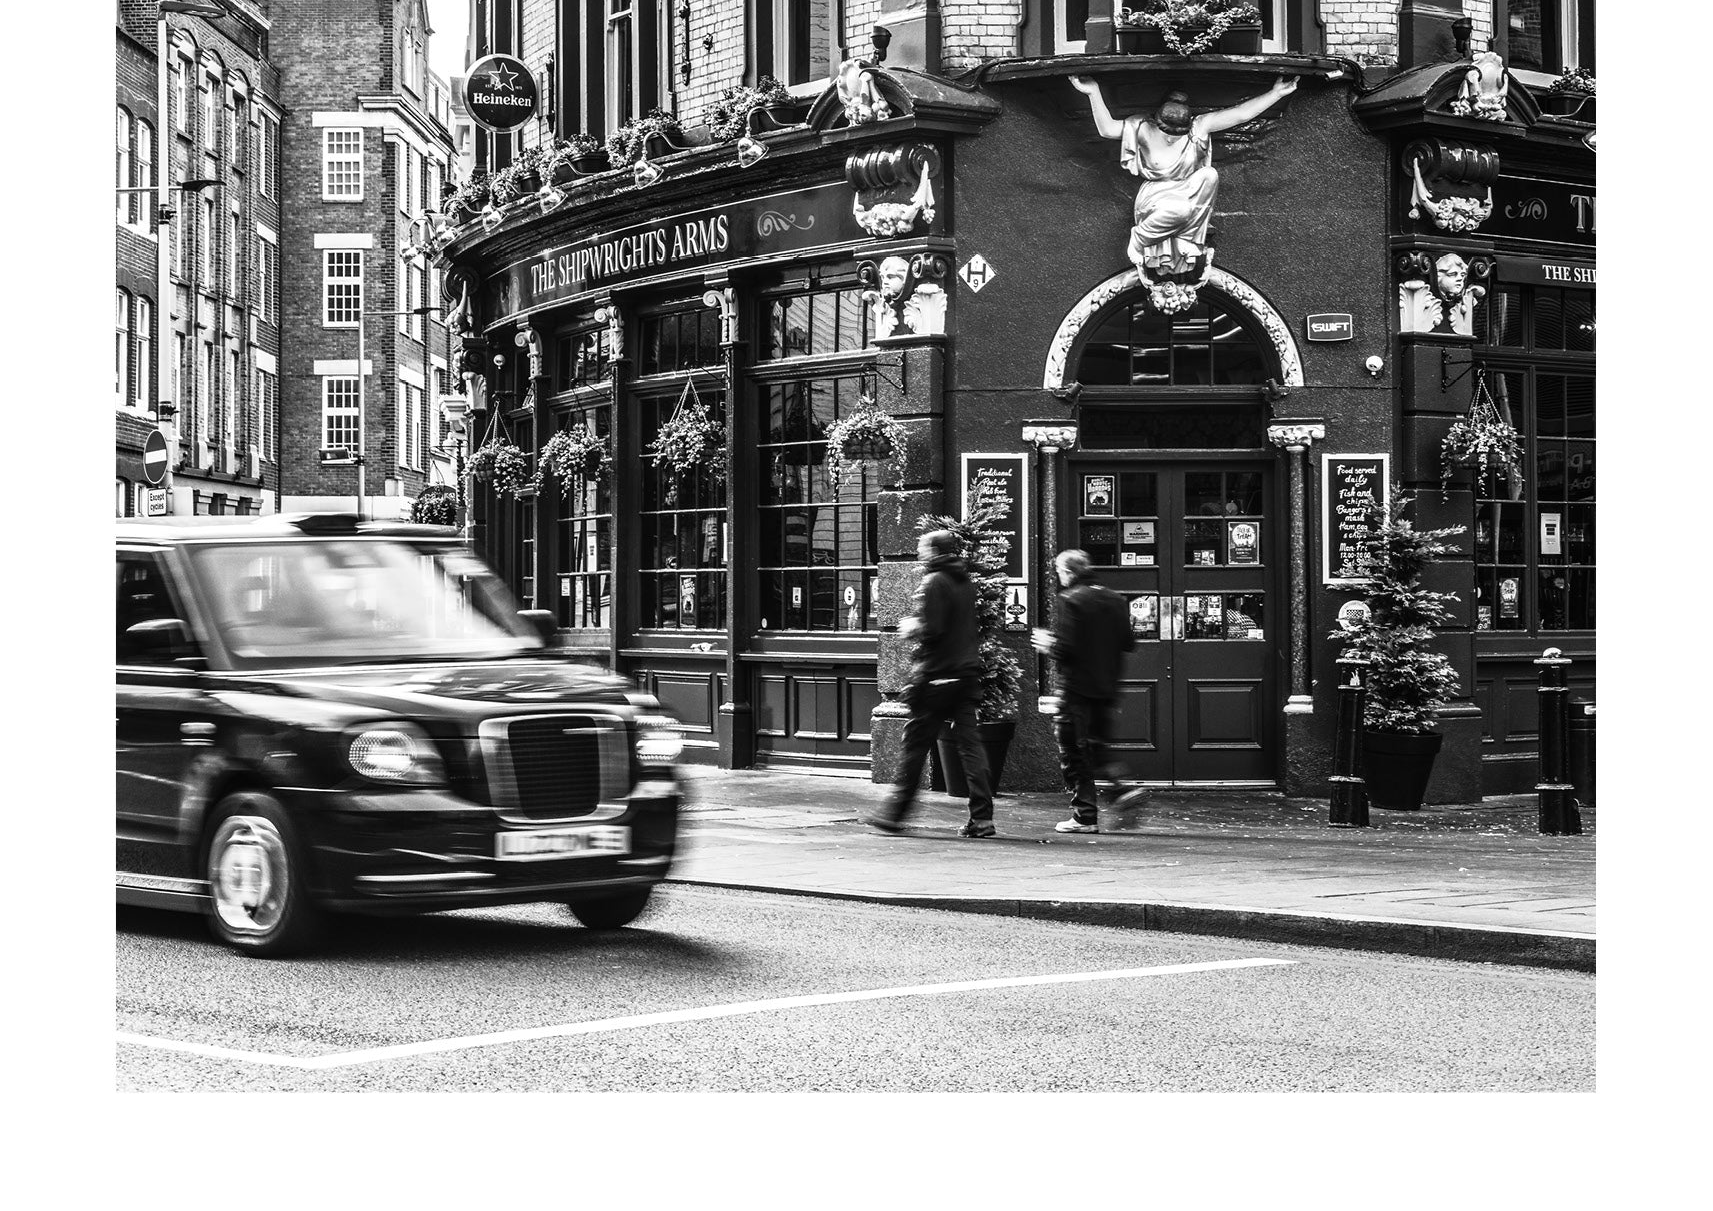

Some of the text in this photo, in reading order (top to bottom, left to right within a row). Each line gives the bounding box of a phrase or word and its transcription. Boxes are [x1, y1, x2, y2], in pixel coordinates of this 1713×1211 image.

[473, 92, 532, 107] Heineken
[531, 214, 729, 296] THE SHIPWRIGHTS ARMS
[967, 262, 986, 283] H
[1542, 264, 1571, 281] THE
[973, 279, 979, 288] 9
[1311, 322, 1350, 332] SWIFT
[1337, 464, 1377, 475] Food served
[1344, 474, 1368, 487] daily
[150, 493, 165, 501] Except
[1339, 487, 1373, 499] Fish and
[150, 503, 164, 511] cycles
